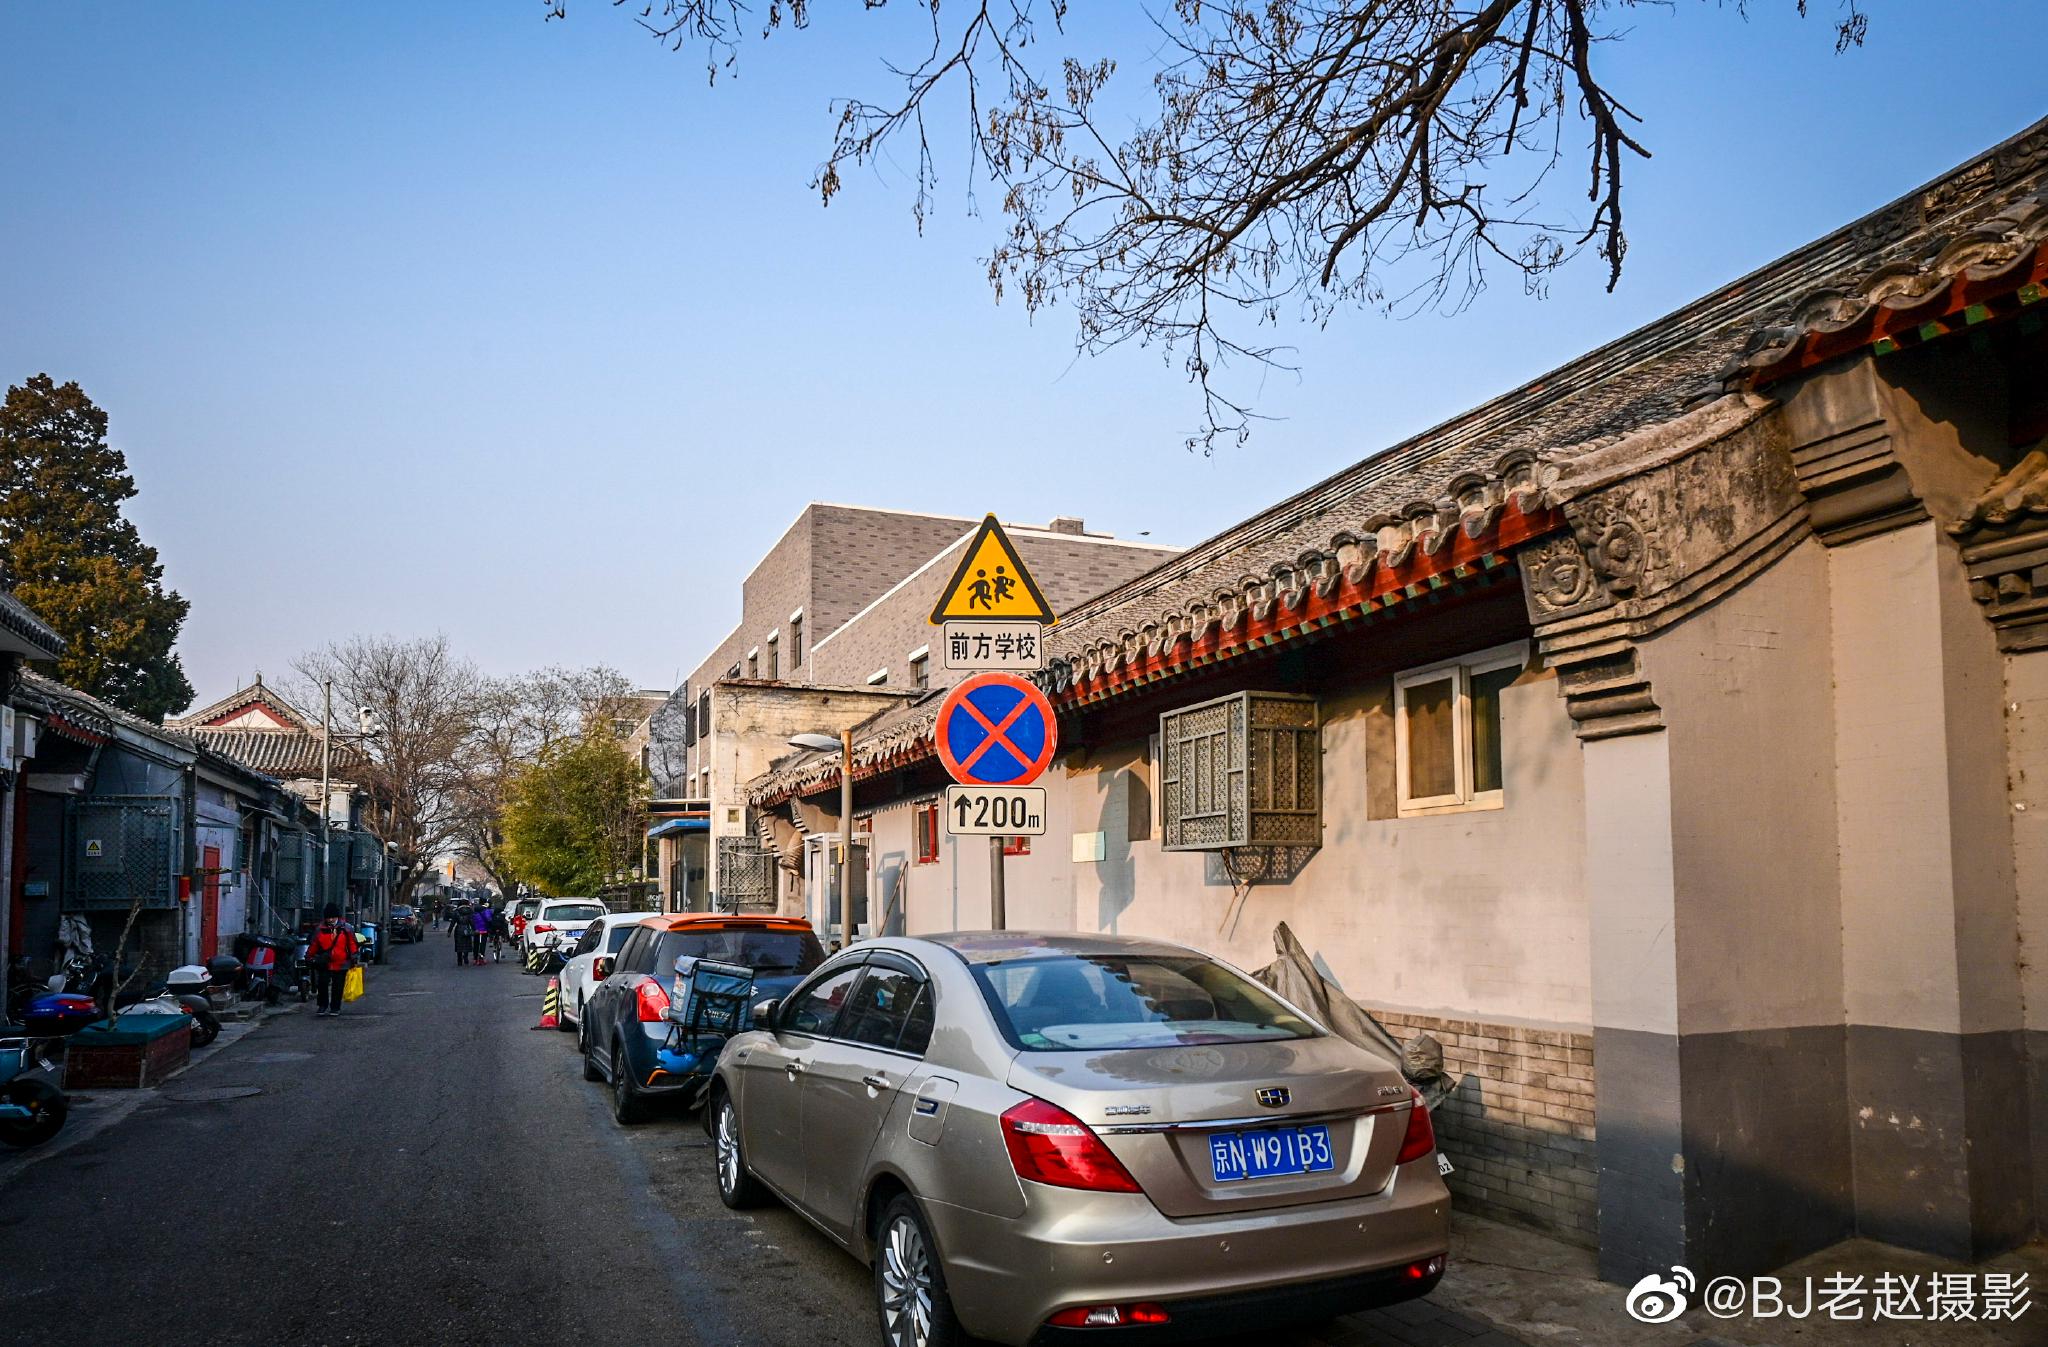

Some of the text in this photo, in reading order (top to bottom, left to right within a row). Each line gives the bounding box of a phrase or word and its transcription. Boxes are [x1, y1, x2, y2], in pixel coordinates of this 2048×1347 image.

[949, 632, 1037, 661] 前方学校
[974, 795, 1040, 829] 200m
